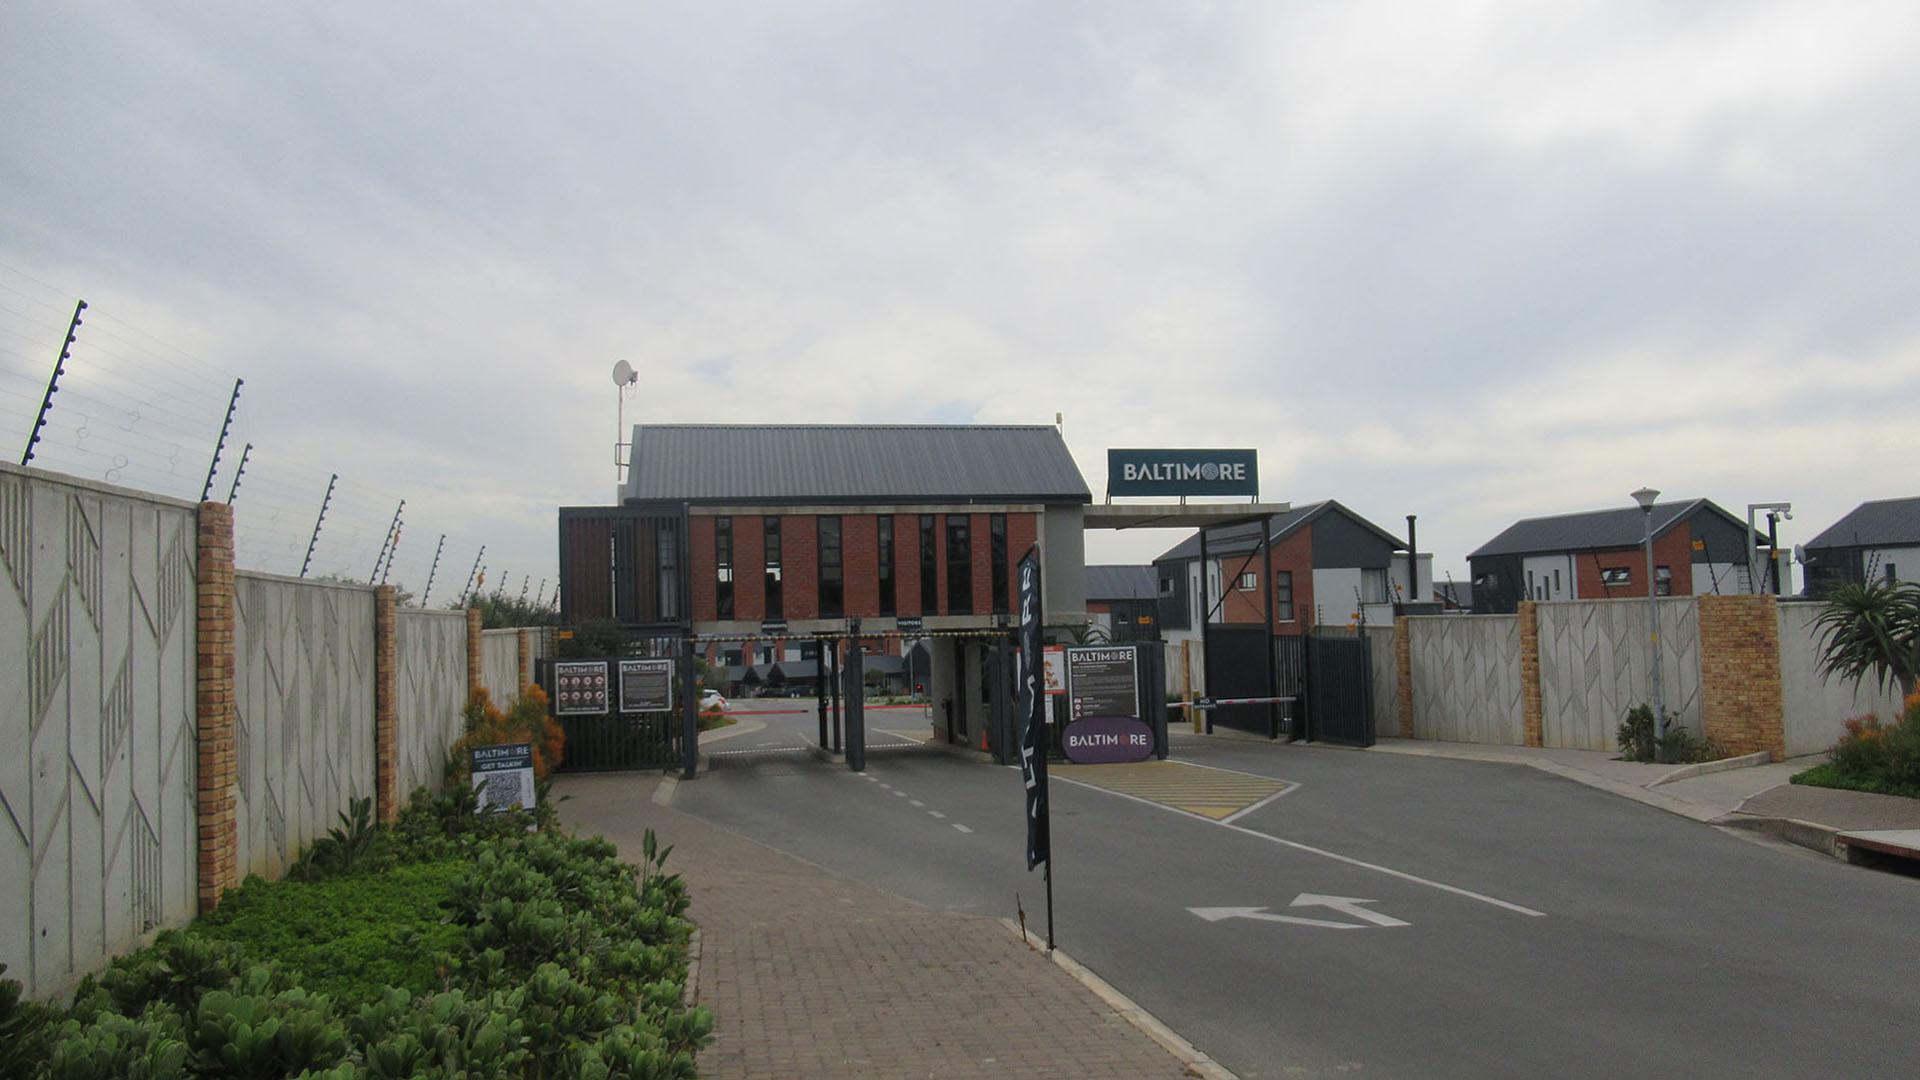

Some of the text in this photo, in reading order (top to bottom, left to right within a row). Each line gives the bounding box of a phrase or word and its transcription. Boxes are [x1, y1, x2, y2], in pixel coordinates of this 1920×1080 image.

[1124, 462, 1246, 481] BALTIMORE
[1072, 651, 1133, 662] BALTIMORE
[559, 666, 604, 674] BALTIMORE
[623, 664, 668, 672] BALTIMORE
[1070, 734, 1147, 747] BALTIMORE
[474, 746, 529, 759] BALTIMORE
